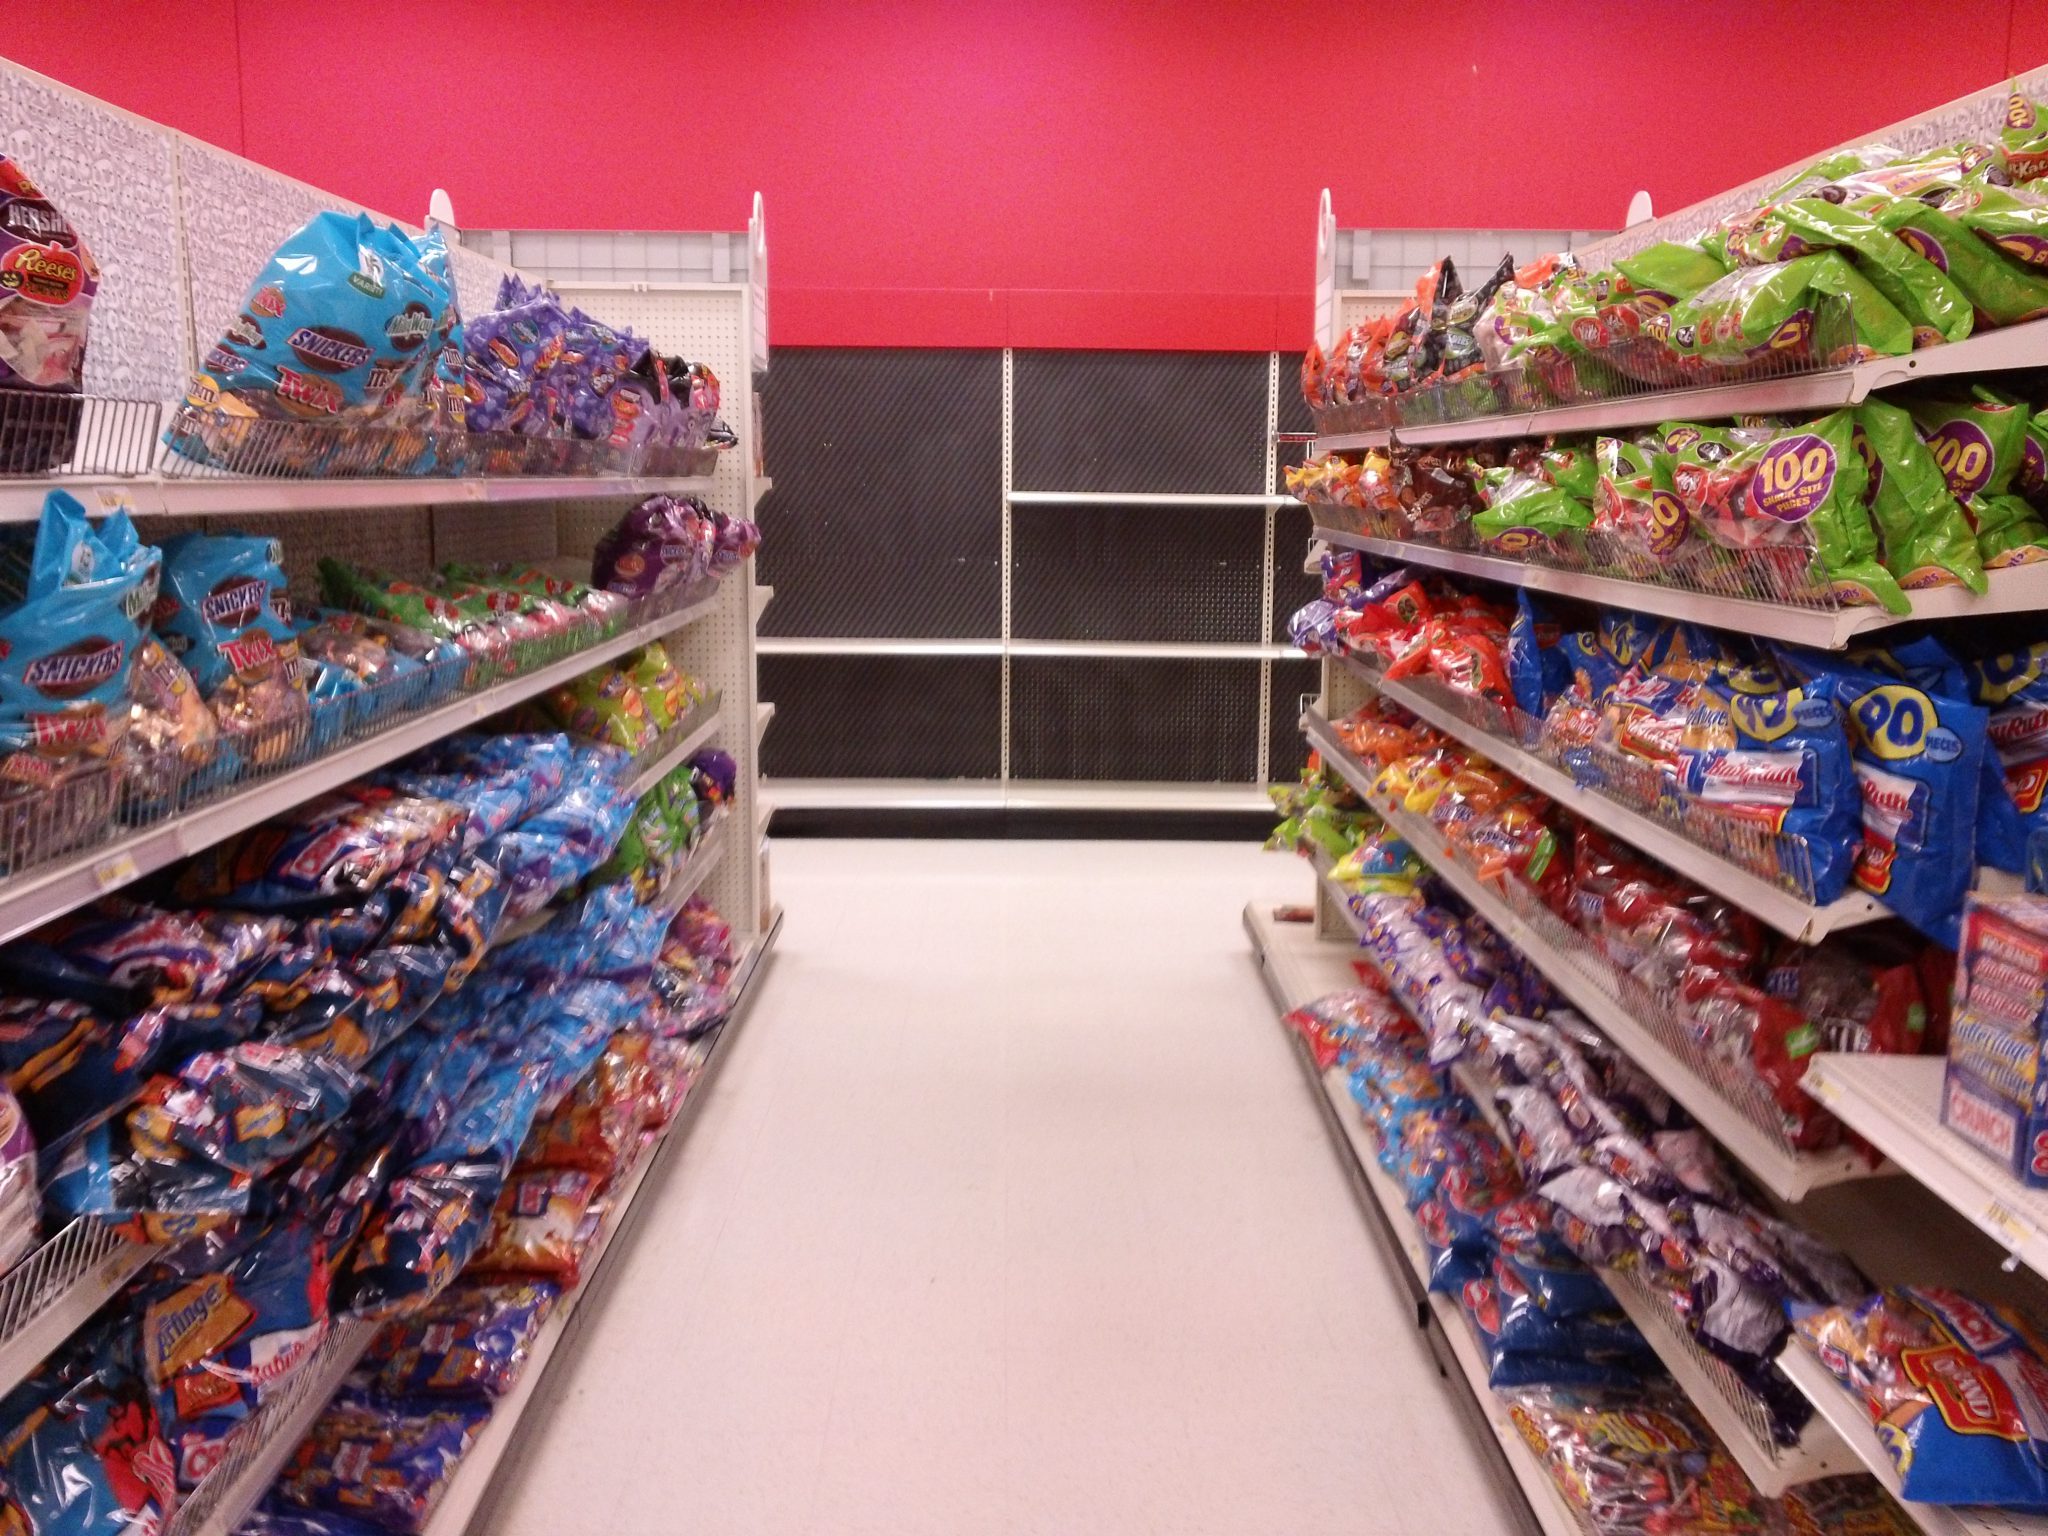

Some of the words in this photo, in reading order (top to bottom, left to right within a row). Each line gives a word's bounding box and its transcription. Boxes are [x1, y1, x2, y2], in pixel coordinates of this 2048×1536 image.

[292, 331, 369, 366] SNICKERS
[1758, 448, 1828, 494] 100
[1799, 482, 1824, 496] SIZE
[206, 583, 264, 619] SNICKERS
[30, 643, 122, 684] SNICKERS
[1858, 694, 1925, 747] 90
